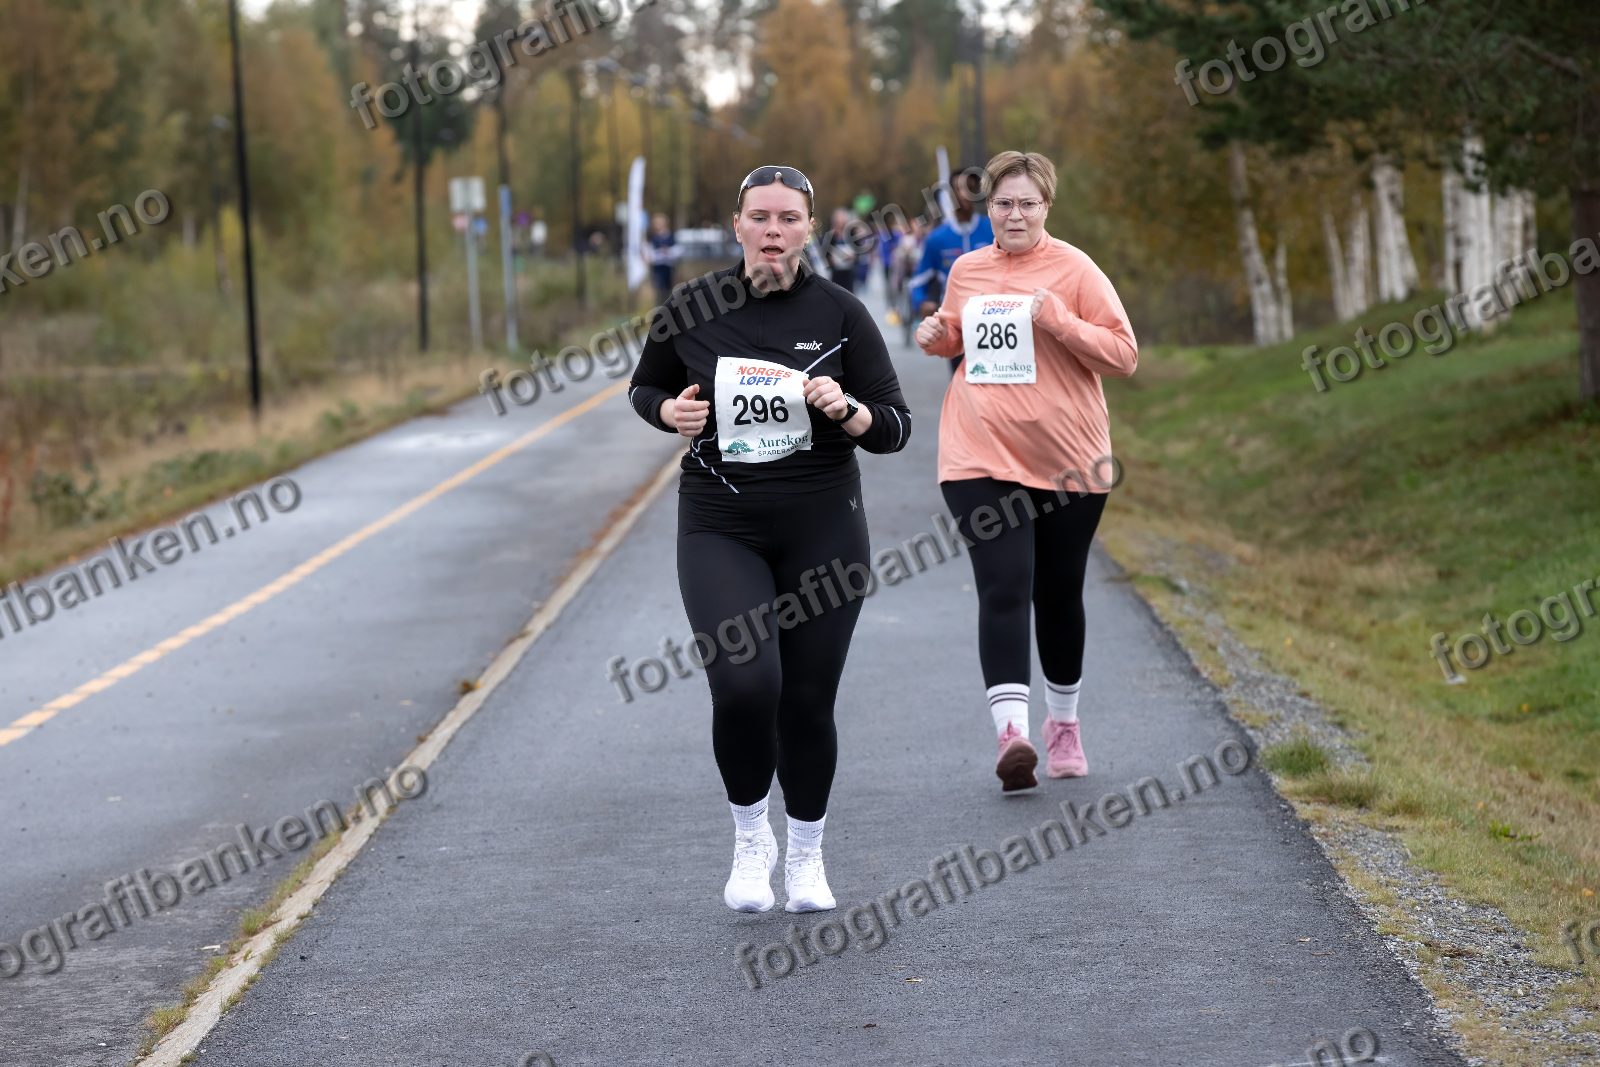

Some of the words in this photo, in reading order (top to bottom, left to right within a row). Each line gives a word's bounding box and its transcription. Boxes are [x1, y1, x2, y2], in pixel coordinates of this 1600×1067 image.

[980, 300, 1024, 308] NORGES
[976, 322, 1018, 350] 286
[737, 365, 793, 379] NORGES
[991, 361, 1033, 374] Aurskog
[739, 375, 781, 387] LØPET
[732, 394, 790, 426] 296
